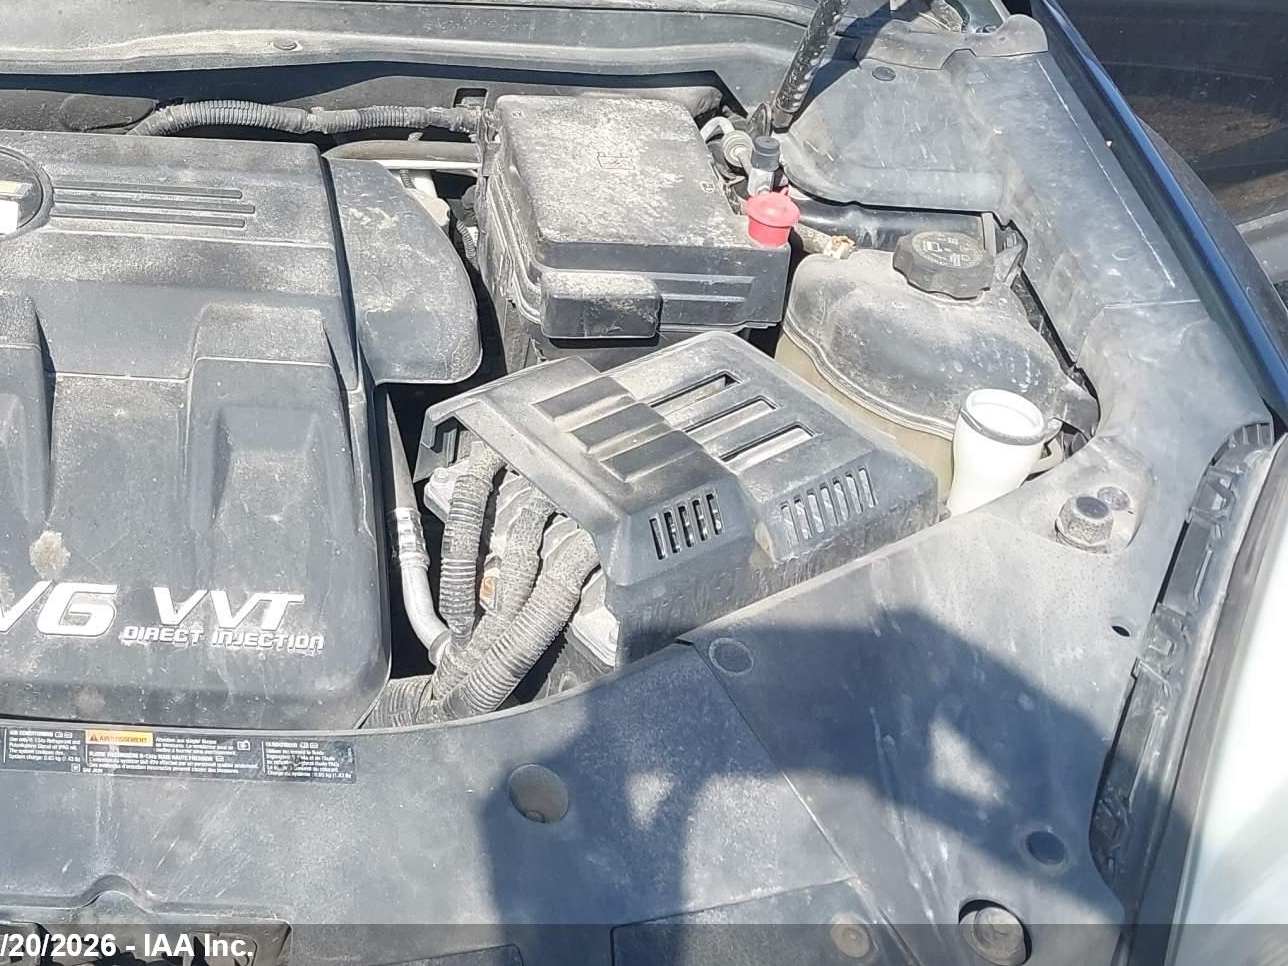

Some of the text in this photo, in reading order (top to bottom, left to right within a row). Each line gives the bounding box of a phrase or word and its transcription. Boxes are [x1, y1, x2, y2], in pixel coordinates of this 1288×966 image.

[152, 586, 305, 631] VVT
[123, 625, 325, 651] DIRECT INJECTION
